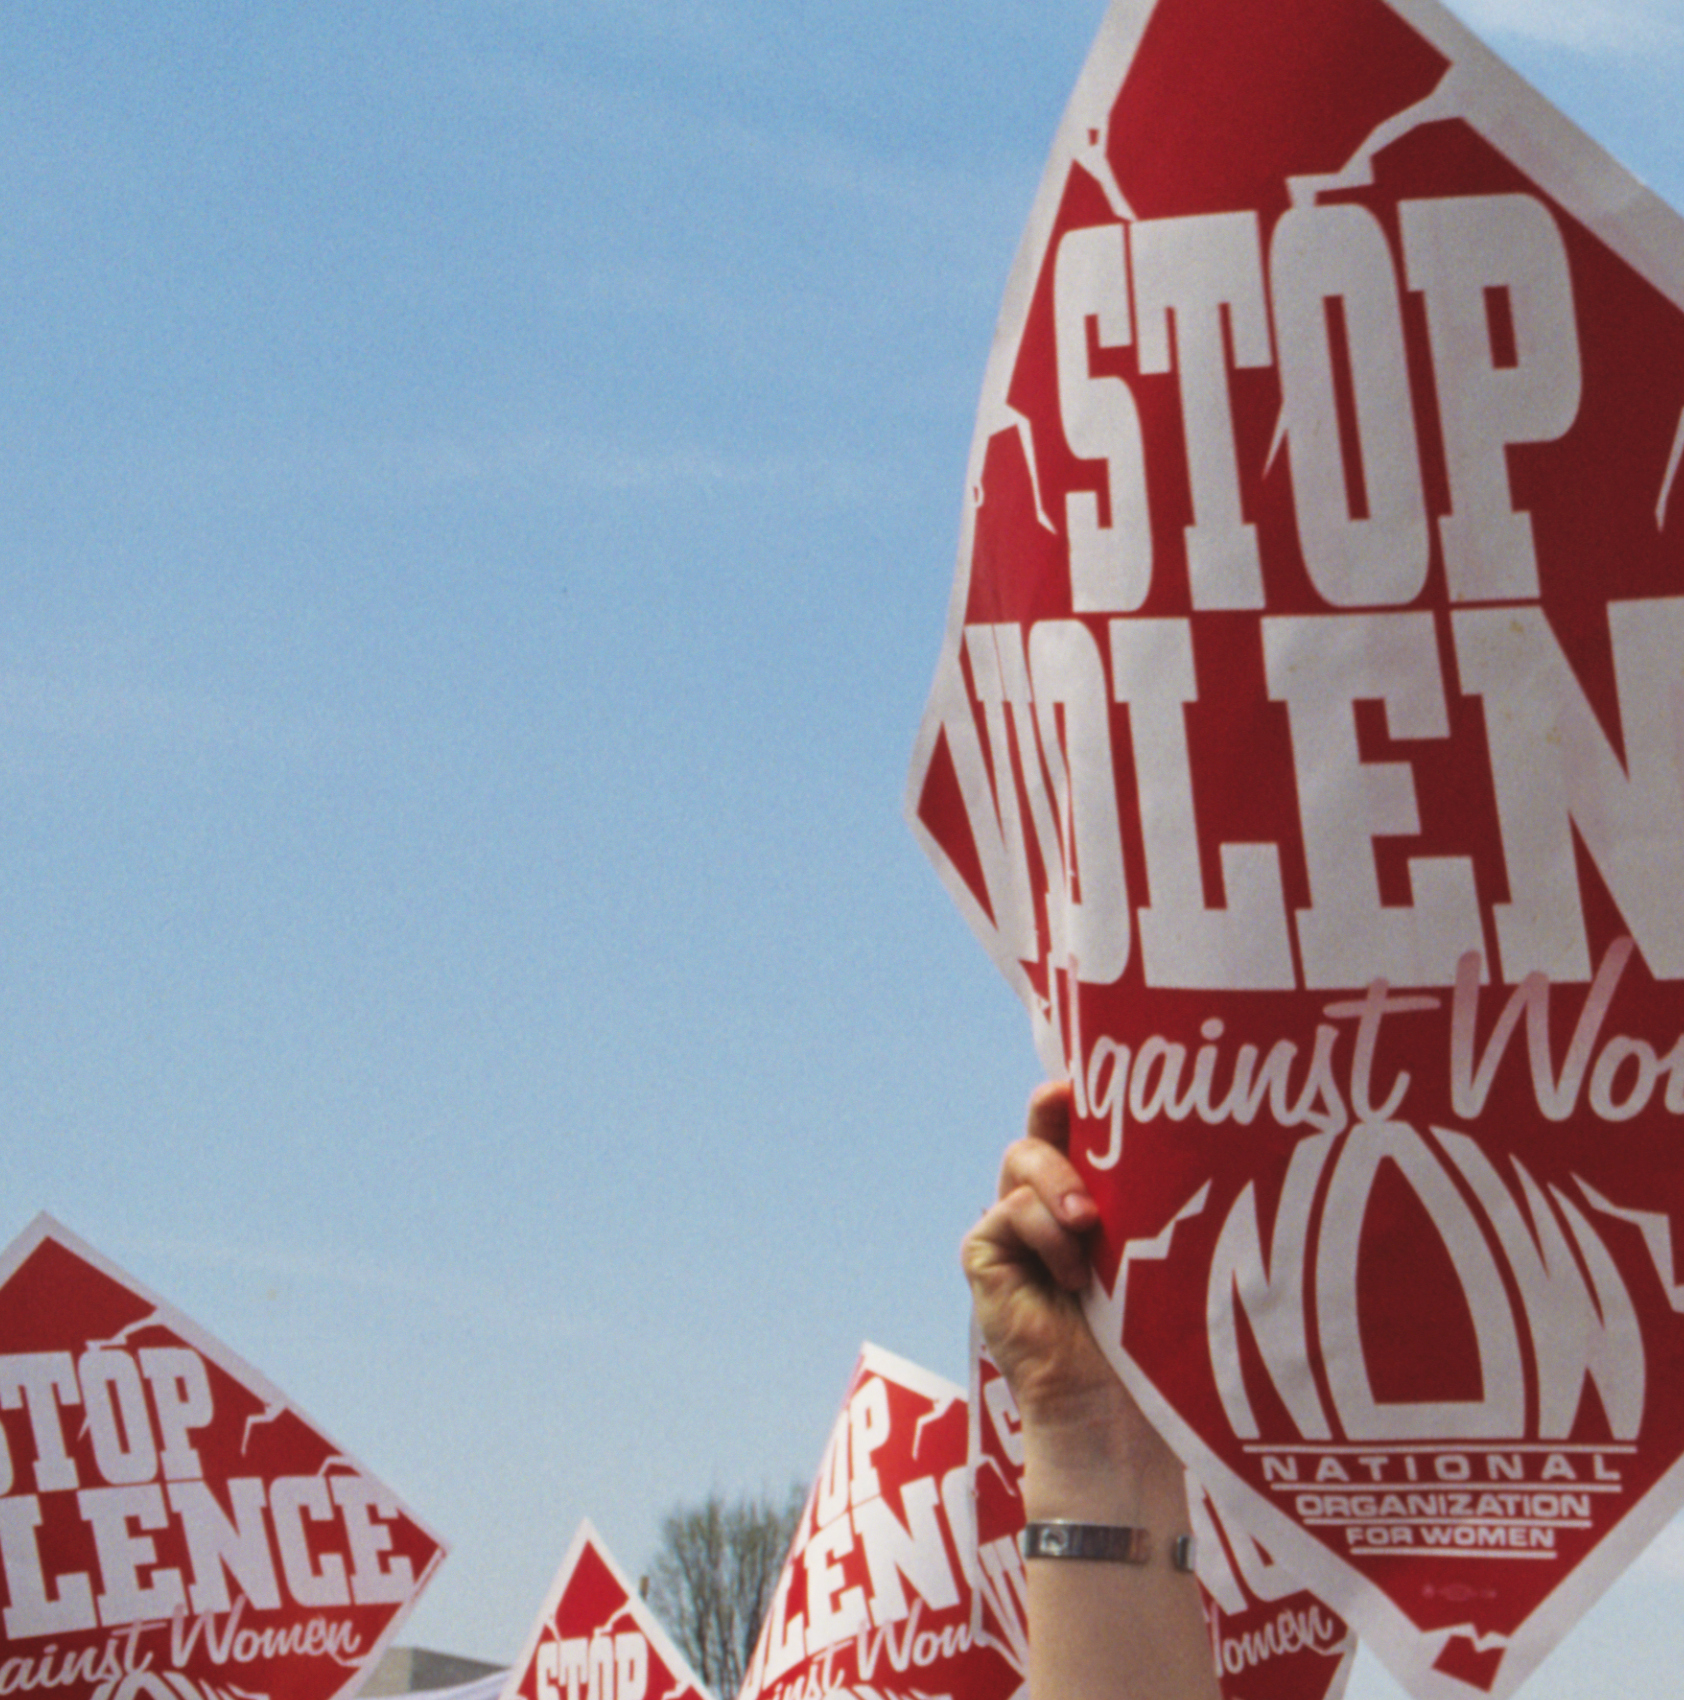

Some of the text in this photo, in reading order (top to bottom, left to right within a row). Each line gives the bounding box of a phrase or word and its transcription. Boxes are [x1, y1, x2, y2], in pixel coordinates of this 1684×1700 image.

[1053, 193, 1583, 614] STOP
[1206, 1119, 1647, 1441] NOW
[1263, 1452, 1621, 1485] NATIONAL
[1295, 1491, 1594, 1520] ORGANIZATION
[1346, 1524, 1555, 1550] FOR WOMEN
[169, 1595, 361, 1668] Women
[1210, 1604, 1334, 1678] omen
